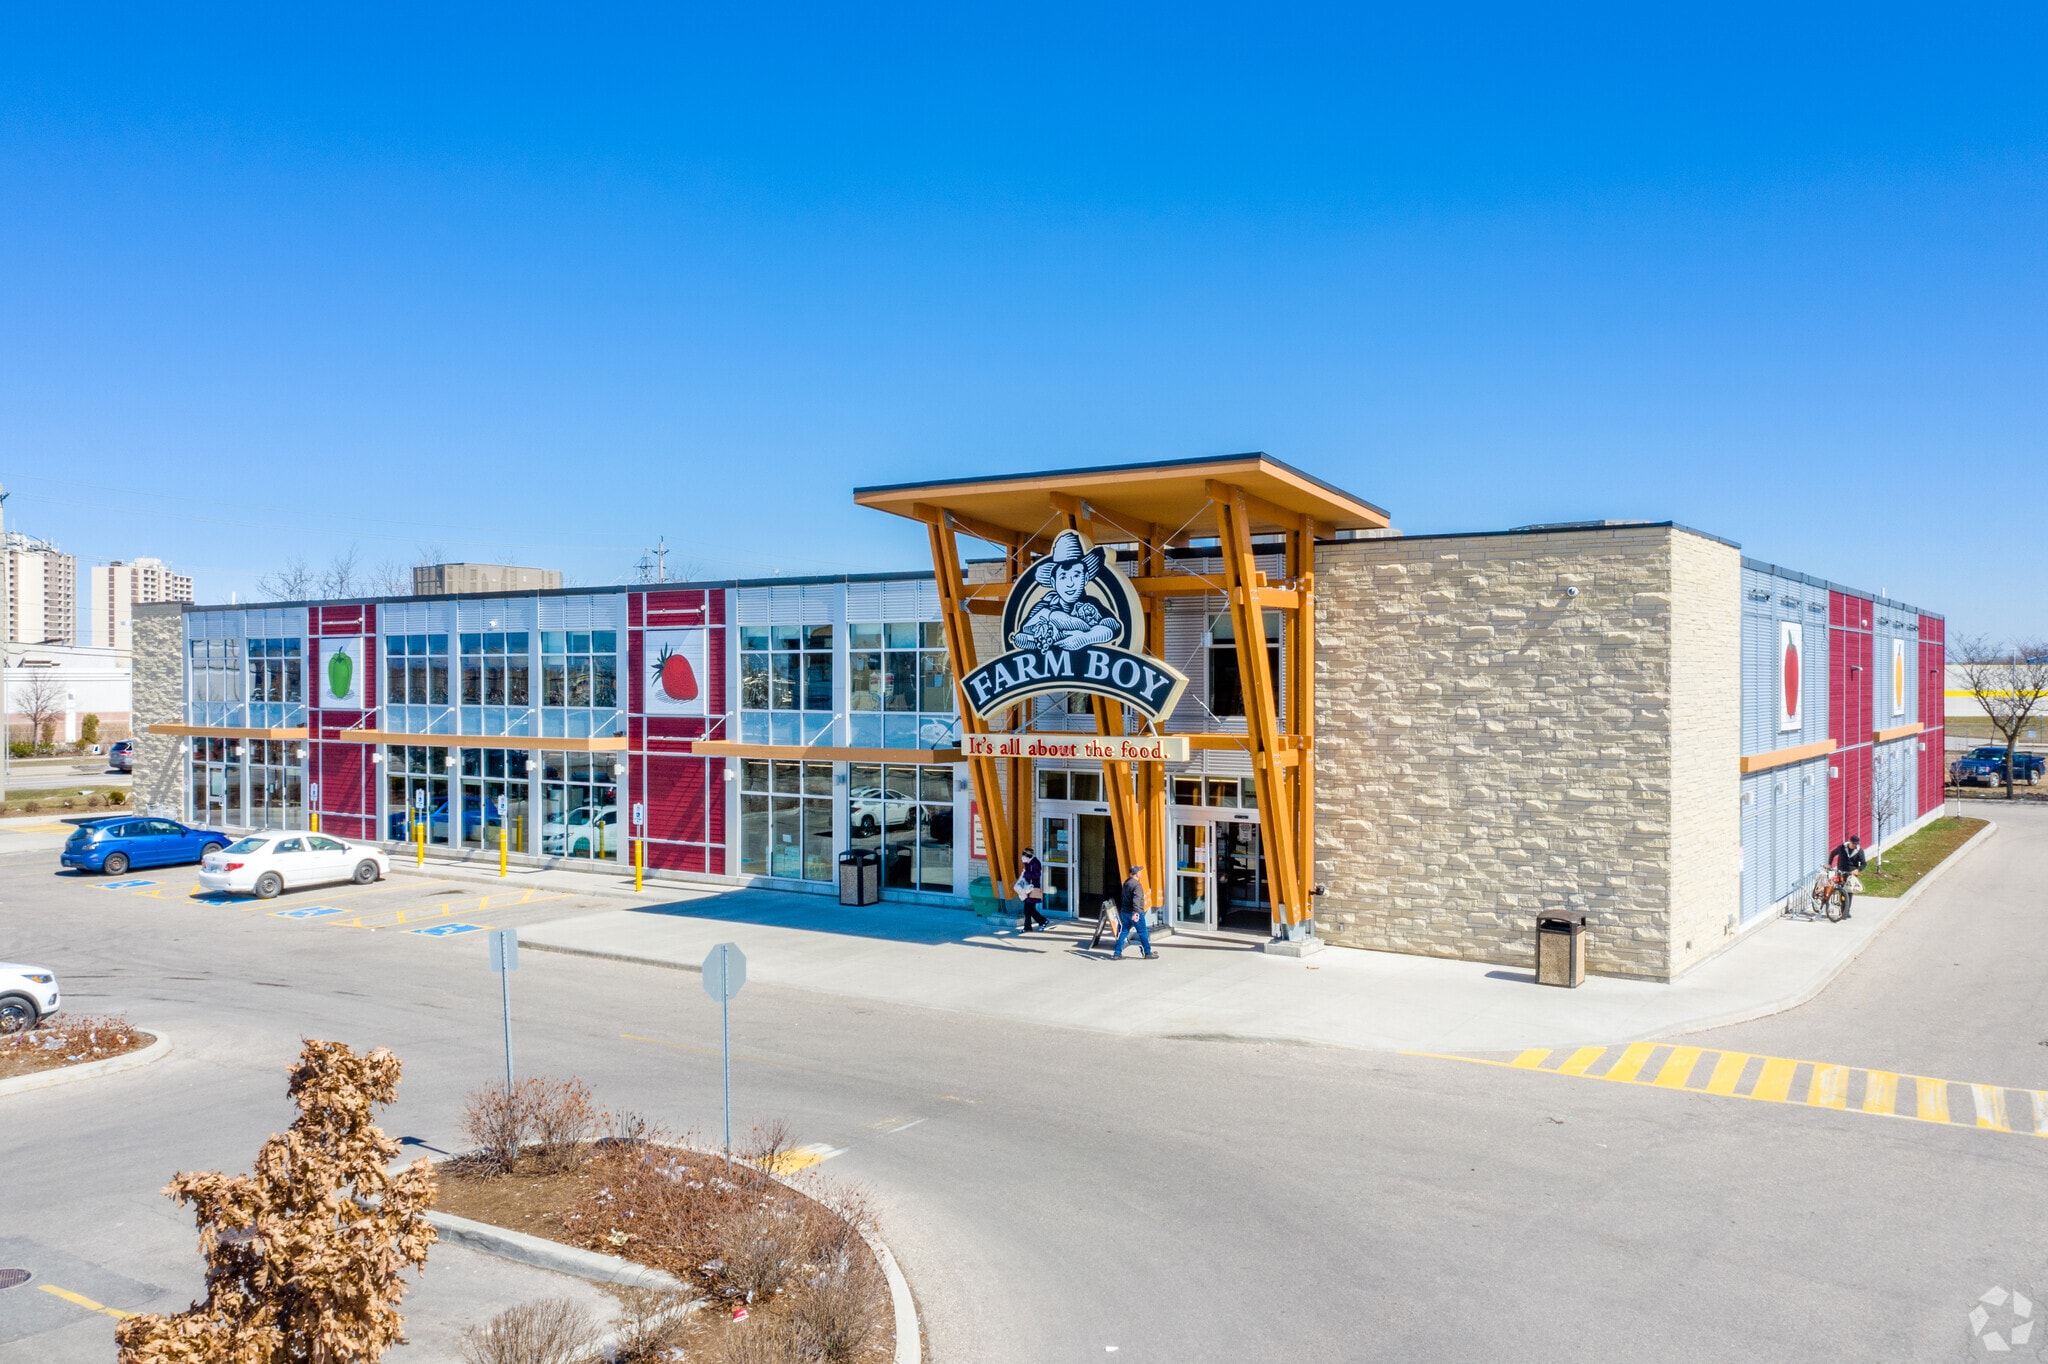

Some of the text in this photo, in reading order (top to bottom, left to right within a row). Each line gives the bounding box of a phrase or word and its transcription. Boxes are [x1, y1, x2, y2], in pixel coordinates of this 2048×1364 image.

[969, 650, 1169, 706] FARM BOY
[969, 736, 1169, 759] It's all about the food.
